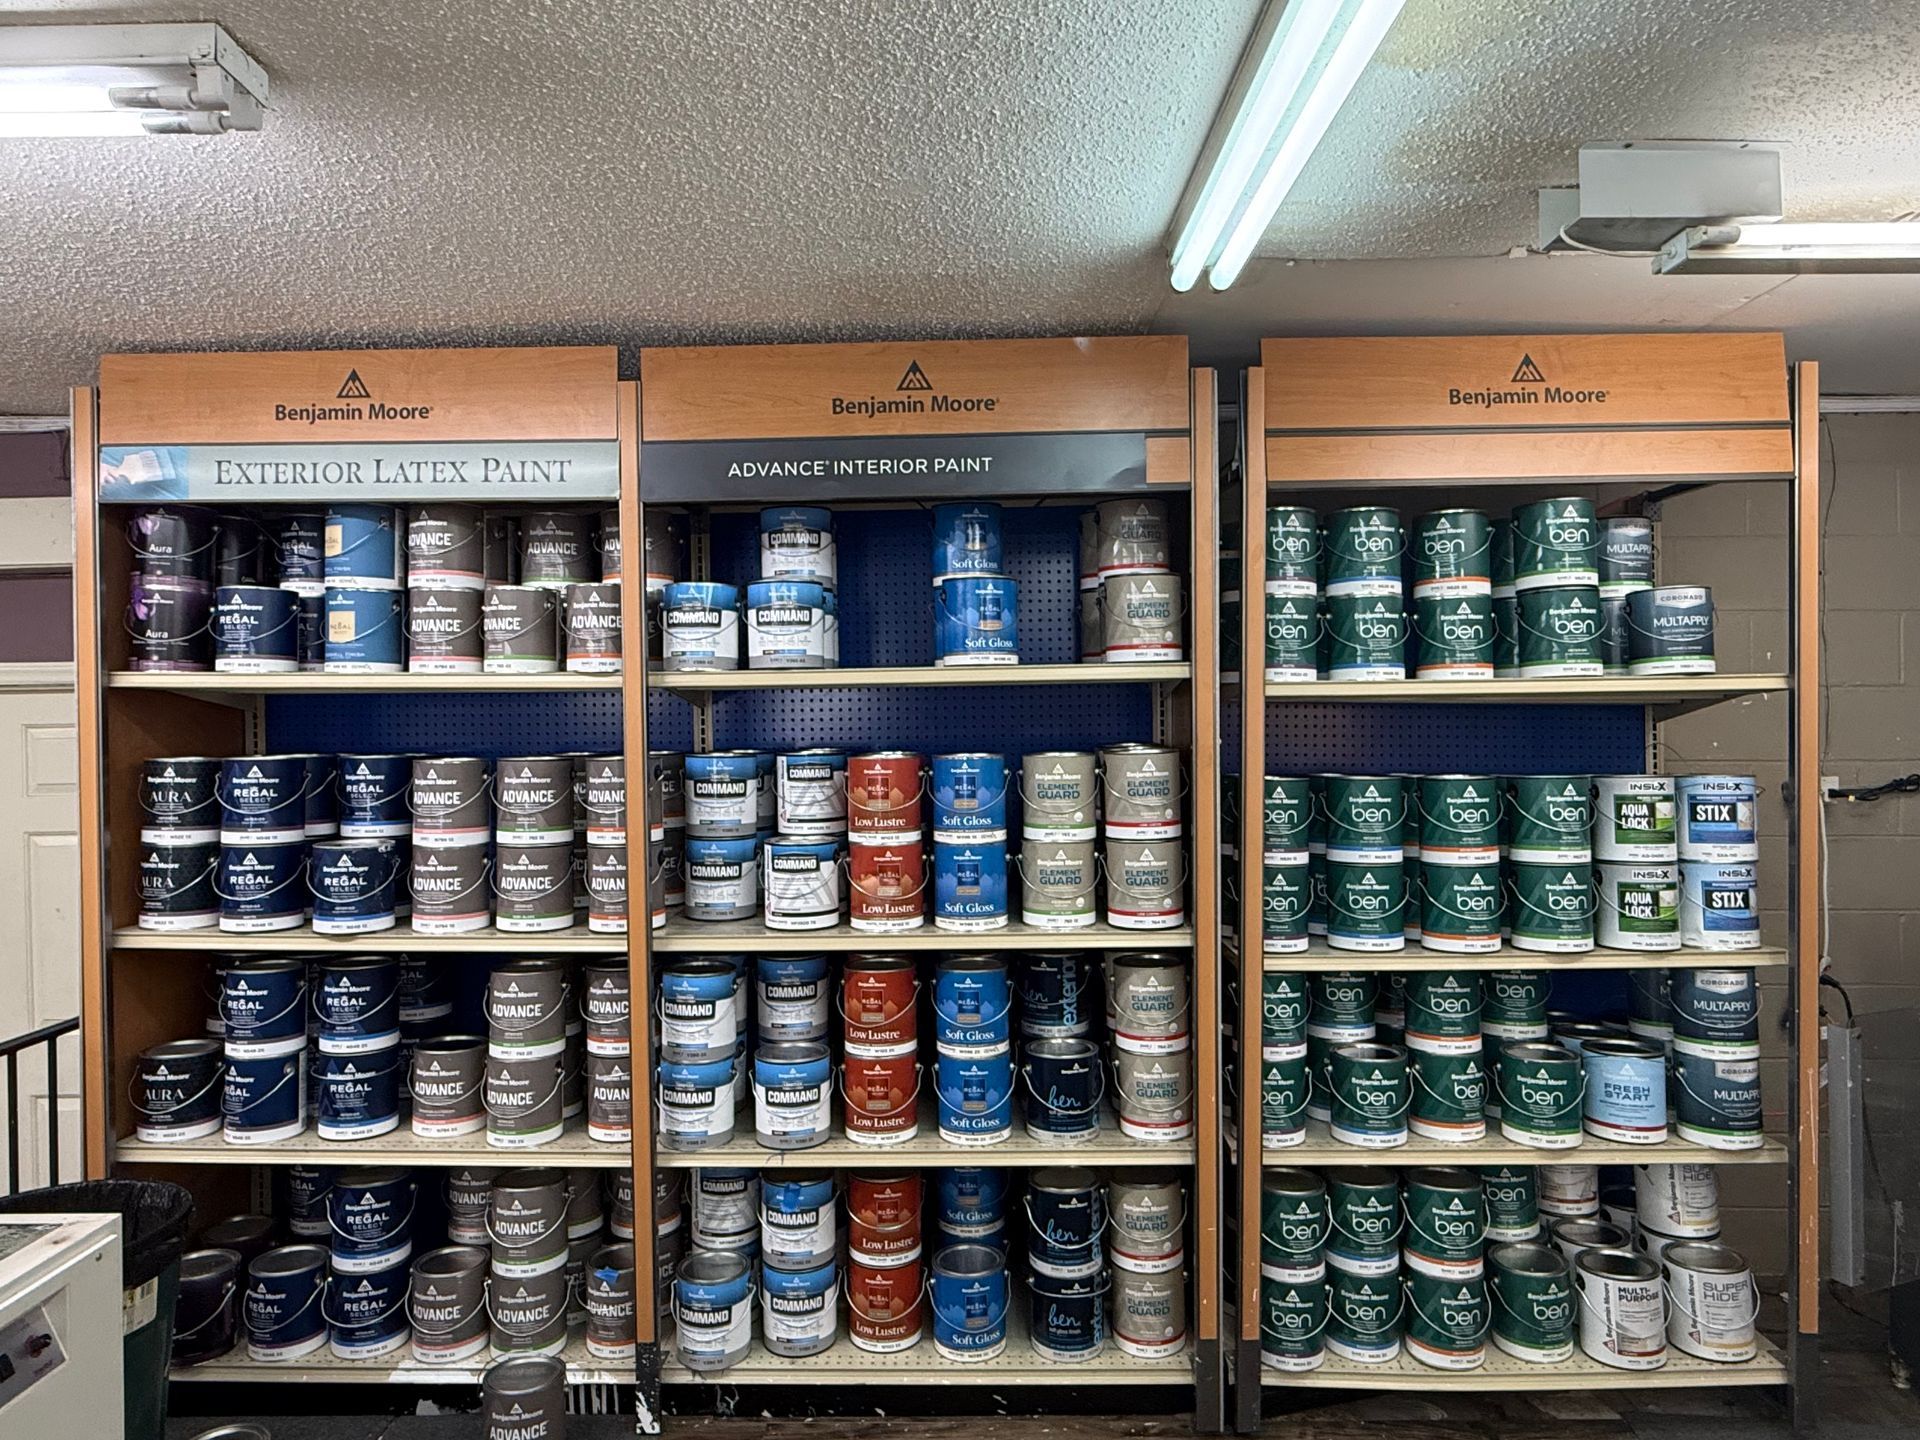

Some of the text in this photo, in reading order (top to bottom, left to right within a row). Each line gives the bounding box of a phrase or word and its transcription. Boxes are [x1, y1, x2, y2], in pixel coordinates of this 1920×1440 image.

[1449, 387, 1607, 417] Benjamin Moore
[275, 402, 434, 433] Benjamin Moore
[831, 403, 996, 427] Benjamin Moore
[727, 456, 992, 481] ADVANCE INTERIOR PAINT
[215, 460, 572, 494] EXTERIOR LATEX PAINT
[770, 532, 819, 545] COMMAND
[1549, 525, 1589, 543] ben
[149, 543, 172, 554] Aura
[1273, 536, 1310, 552] ben
[1355, 536, 1393, 552] ben
[1425, 537, 1465, 555] ben
[952, 559, 998, 570] Soft Gloss
[1127, 601, 1170, 610] ELEMENT
[219, 614, 259, 625] REGAL
[668, 611, 719, 624] COMMAND
[758, 609, 811, 622] COMMAND
[1128, 609, 1171, 618] GUARD
[412, 619, 462, 632] ADVANCE
[1554, 617, 1594, 634] ben
[1653, 615, 1709, 627] MULTAPPLY
[145, 629, 169, 638] Aura
[1269, 622, 1307, 639] ben
[1359, 622, 1398, 639] ben
[1443, 622, 1483, 639] ben
[964, 637, 1013, 648] Soft Gloss
[789, 768, 831, 779] COMMAND
[346, 784, 383, 793] REGAL
[696, 782, 745, 795] COMMAND
[1036, 782, 1079, 791] ELEMENT
[1126, 779, 1170, 788] ELEMENT
[150, 790, 193, 802] AURA
[233, 787, 278, 798] REGAL
[414, 791, 462, 804] ADVANCE
[503, 789, 556, 802] ADVANCE
[1036, 790, 1081, 800] GUARD
[1127, 787, 1171, 797] GUARD
[1351, 804, 1391, 822] ben
[1449, 805, 1489, 823] ben
[1550, 803, 1587, 821] ben
[1621, 803, 1649, 816] AQUA
[1696, 804, 1730, 821] STIX
[854, 816, 906, 827] Low Lustre
[942, 815, 992, 826] Soft Gloss
[1621, 817, 1649, 830] LOCK
[773, 858, 817, 870] COMMAND
[692, 864, 740, 878] COMMAND
[1039, 868, 1081, 877] ELEMENT
[1124, 869, 1168, 877] ELEMENT
[229, 876, 274, 885] REGAL
[324, 876, 368, 886] REGAL
[414, 876, 464, 890] ADVANCE
[501, 876, 554, 889] ADVANCE
[1039, 876, 1082, 886] GUARD
[1125, 876, 1169, 887] GUARD
[1348, 891, 1389, 910] ben
[1456, 893, 1494, 911] ben
[1548, 892, 1588, 910] ben
[1624, 892, 1653, 905] AQUA
[1711, 892, 1745, 909] STIX
[862, 903, 915, 914] Low Lustre
[945, 902, 994, 913] Soft Gloss
[1625, 905, 1653, 918] LOCK
[767, 985, 816, 997] COMMAND
[1325, 984, 1363, 1001] ben
[1496, 980, 1535, 999] ben
[327, 997, 367, 1007] REGAL
[1131, 995, 1173, 1003] ELEMENT
[1430, 995, 1470, 1012] ben
[1694, 999, 1751, 1012] MULTAPPLY
[227, 1001, 264, 1011] REGAL
[492, 1003, 545, 1017] ADVANCE
[665, 1002, 713, 1016] COMMAND
[1131, 1003, 1175, 1011] GUARD
[1264, 1001, 1300, 1018] ben
[849, 1029, 900, 1040] Low Lustre
[945, 1029, 995, 1040] Soft Gloss
[329, 1084, 372, 1094] REGAL
[414, 1081, 465, 1096] ADVANCE
[1136, 1081, 1178, 1090] ELEMENT
[1454, 1082, 1484, 1099] ben
[1604, 1083, 1651, 1094] FRESH
[144, 1088, 186, 1100] AURA
[486, 1091, 536, 1105] ADVANCE
[663, 1090, 713, 1103] COMMAND
[767, 1089, 819, 1103] COMMAND
[1136, 1089, 1180, 1098] GUARD
[1356, 1088, 1396, 1105] ben
[1521, 1086, 1564, 1105] ben
[1604, 1090, 1651, 1102] START
[853, 1116, 905, 1126] Low Lustre
[950, 1117, 1000, 1129] Soft Gloss
[1682, 1171, 1713, 1182] HIDE
[702, 1180, 745, 1192] COMMAND
[1485, 1183, 1526, 1202] ben
[347, 1213, 390, 1225] REGAL
[767, 1212, 817, 1225] COMMAND
[946, 1209, 993, 1221] Soft Gloss
[1125, 1213, 1168, 1222] ELEMENT
[495, 1219, 546, 1235] ADVANCE
[1125, 1221, 1169, 1231] GUARD
[1351, 1213, 1391, 1232] ben
[1434, 1216, 1475, 1236] ben
[1282, 1221, 1320, 1240] ben
[862, 1237, 914, 1250] Low Lustre
[1618, 1286, 1650, 1297] MULTI-
[1702, 1279, 1749, 1293] SUPER
[1127, 1298, 1170, 1307] ELEMENT
[1618, 1292, 1660, 1303] PURPOSE
[1703, 1291, 1741, 1302] HIDE
[344, 1300, 386, 1312] REGAL
[772, 1296, 823, 1311] COMMAND
[1345, 1299, 1386, 1320] ben
[413, 1305, 463, 1320] ADVANCE
[496, 1304, 551, 1321] ADVANCE
[680, 1309, 729, 1322] COMMAND
[1127, 1306, 1170, 1317] GUARD
[1271, 1306, 1313, 1328] ben
[1443, 1306, 1480, 1325] ben
[1533, 1301, 1569, 1320] ben
[856, 1321, 907, 1336] Low Lustre
[952, 1330, 1000, 1345] Soft Gloss
[489, 1420, 550, 1440] ADVANCE
